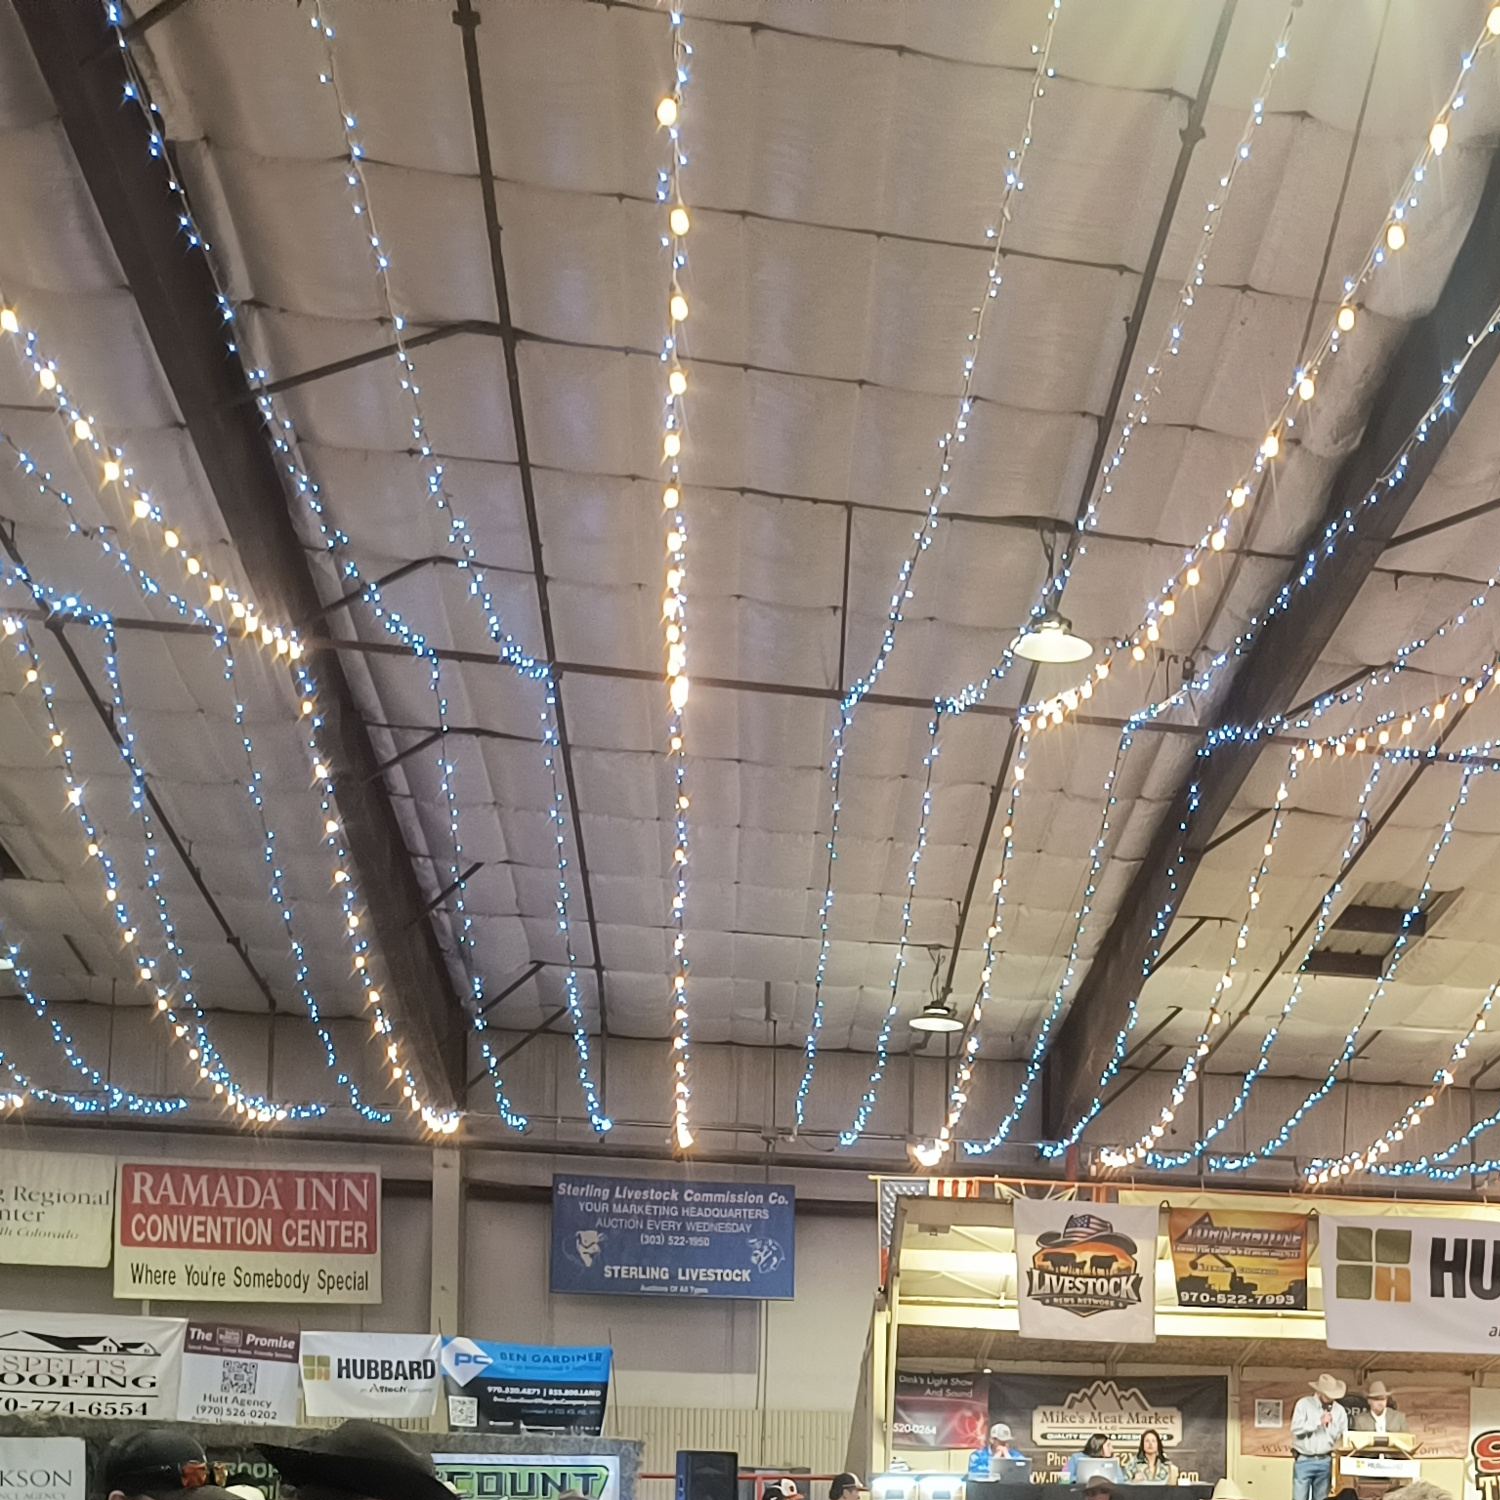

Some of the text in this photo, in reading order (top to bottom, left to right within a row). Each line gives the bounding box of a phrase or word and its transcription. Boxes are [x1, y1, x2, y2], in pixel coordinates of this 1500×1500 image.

[14, 1185, 110, 1208] Regional
[132, 1171, 369, 1213] RAMADA INN
[557, 1182, 789, 1205] Sterling Livestock Commission Co.
[579, 1201, 770, 1220] YOUR MARKETING HEADQUARTERS
[131, 1212, 368, 1249] CONVENTION CENTER
[595, 1217, 752, 1234] AUCTION EVERY WEDNESDAY
[640, 1232, 665, 1246] (303)
[130, 1262, 369, 1295] Where You're Somebody Special
[604, 1265, 751, 1282] STERLING LIVESTOCK
[1030, 1268, 1140, 1301] LIVESTOCK
[1180, 1291, 1295, 1306] 970-522-7993
[189, 1326, 213, 1342] The
[245, 1332, 296, 1350] Promise
[2, 1354, 127, 1377] SPELTS
[500, 1351, 603, 1364] BEN GARDINER
[337, 1357, 436, 1382] HUBBARD
[231, 1395, 273, 1409] Agency
[924, 1388, 973, 1398] And Sound
[0, 1397, 149, 1417] 0-774-6554
[196, 1404, 278, 1420] (970) 526-0202
[1040, 1410, 1175, 1425] Mike's Meat Market
[438, 1470, 601, 1499] COUNT
